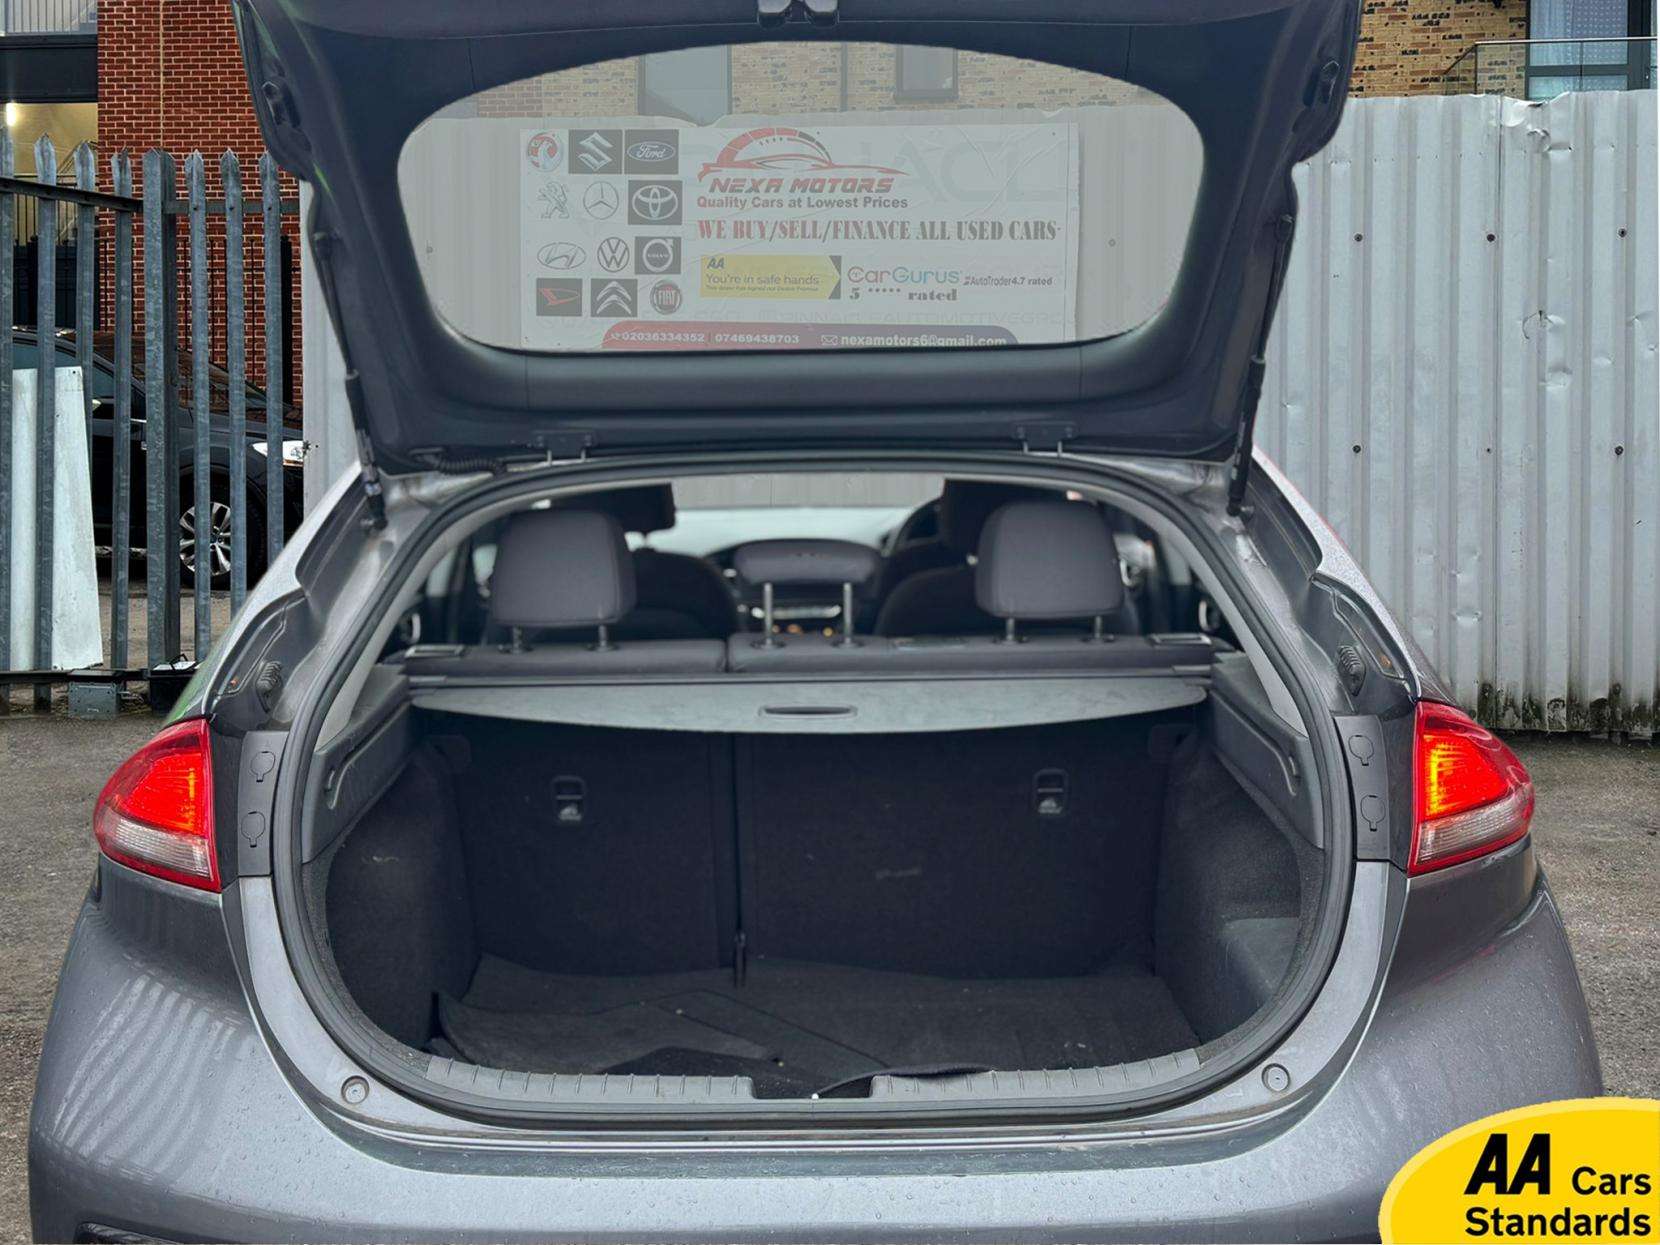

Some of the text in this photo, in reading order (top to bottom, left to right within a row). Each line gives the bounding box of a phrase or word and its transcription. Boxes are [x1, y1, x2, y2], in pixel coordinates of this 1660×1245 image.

[636, 143, 666, 159] Ford
[708, 177, 895, 194] NEXA MOTORS
[696, 195, 909, 209] Quality Cars at Lowest Prices
[696, 219, 727, 240] WE
[915, 220, 951, 241] ALL
[956, 220, 1004, 241] USED
[1008, 220, 1058, 241] CARS
[706, 256, 725, 269] AA
[706, 273, 820, 286] You're in safe hands
[847, 266, 961, 285] CarGurus
[1027, 276, 1054, 286] rated
[657, 290, 677, 305] FIAT
[849, 287, 861, 300] 5
[908, 288, 958, 301] rated
